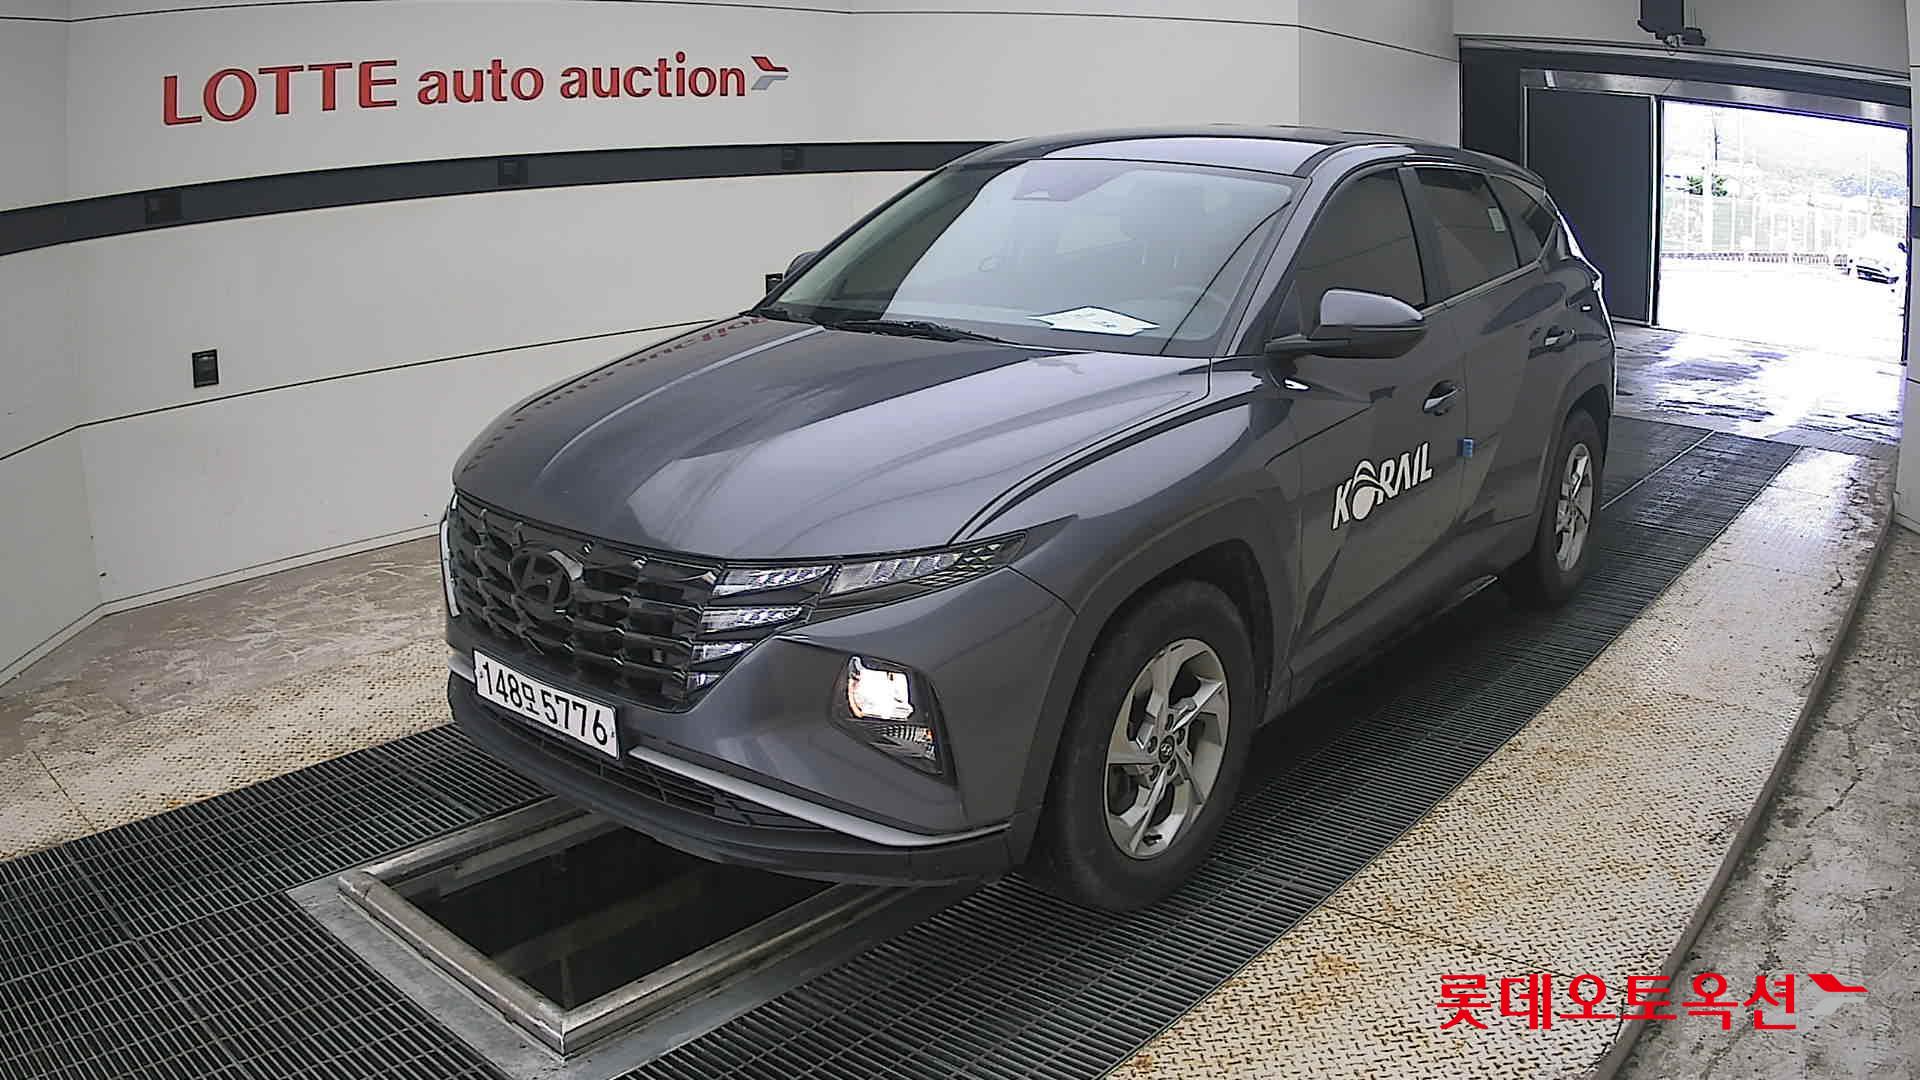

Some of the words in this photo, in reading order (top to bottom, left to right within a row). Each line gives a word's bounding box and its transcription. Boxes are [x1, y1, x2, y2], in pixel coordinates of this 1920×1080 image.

[162, 60, 398, 126] LOTTE
[417, 58, 545, 105] auto
[560, 51, 747, 98] auction
[1332, 441, 1434, 530] KORAIL
